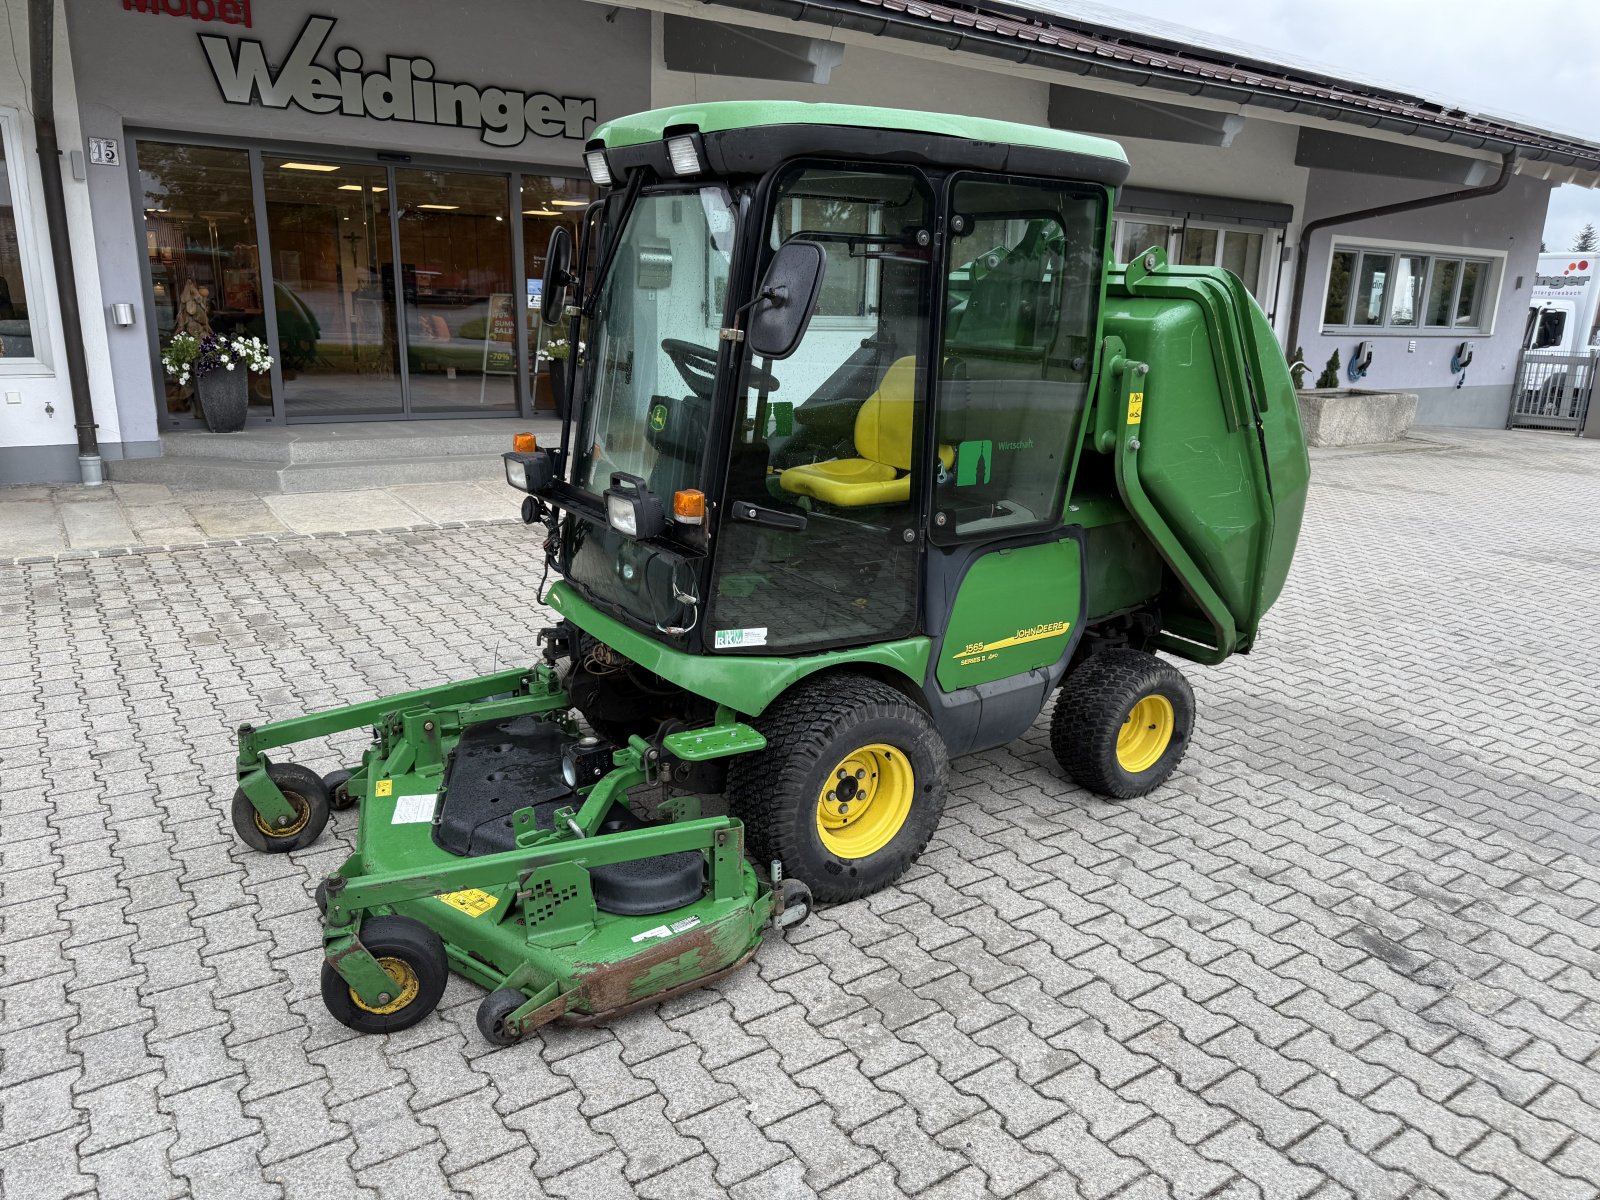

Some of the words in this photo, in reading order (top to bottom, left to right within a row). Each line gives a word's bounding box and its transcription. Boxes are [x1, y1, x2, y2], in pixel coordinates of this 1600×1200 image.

[197, 14, 597, 147] Weidinger
[494, 327, 513, 335] SALE
[1013, 627, 1036, 640] JOHN
[1036, 621, 1064, 635] DEERE
[965, 642, 984, 654] 1565
